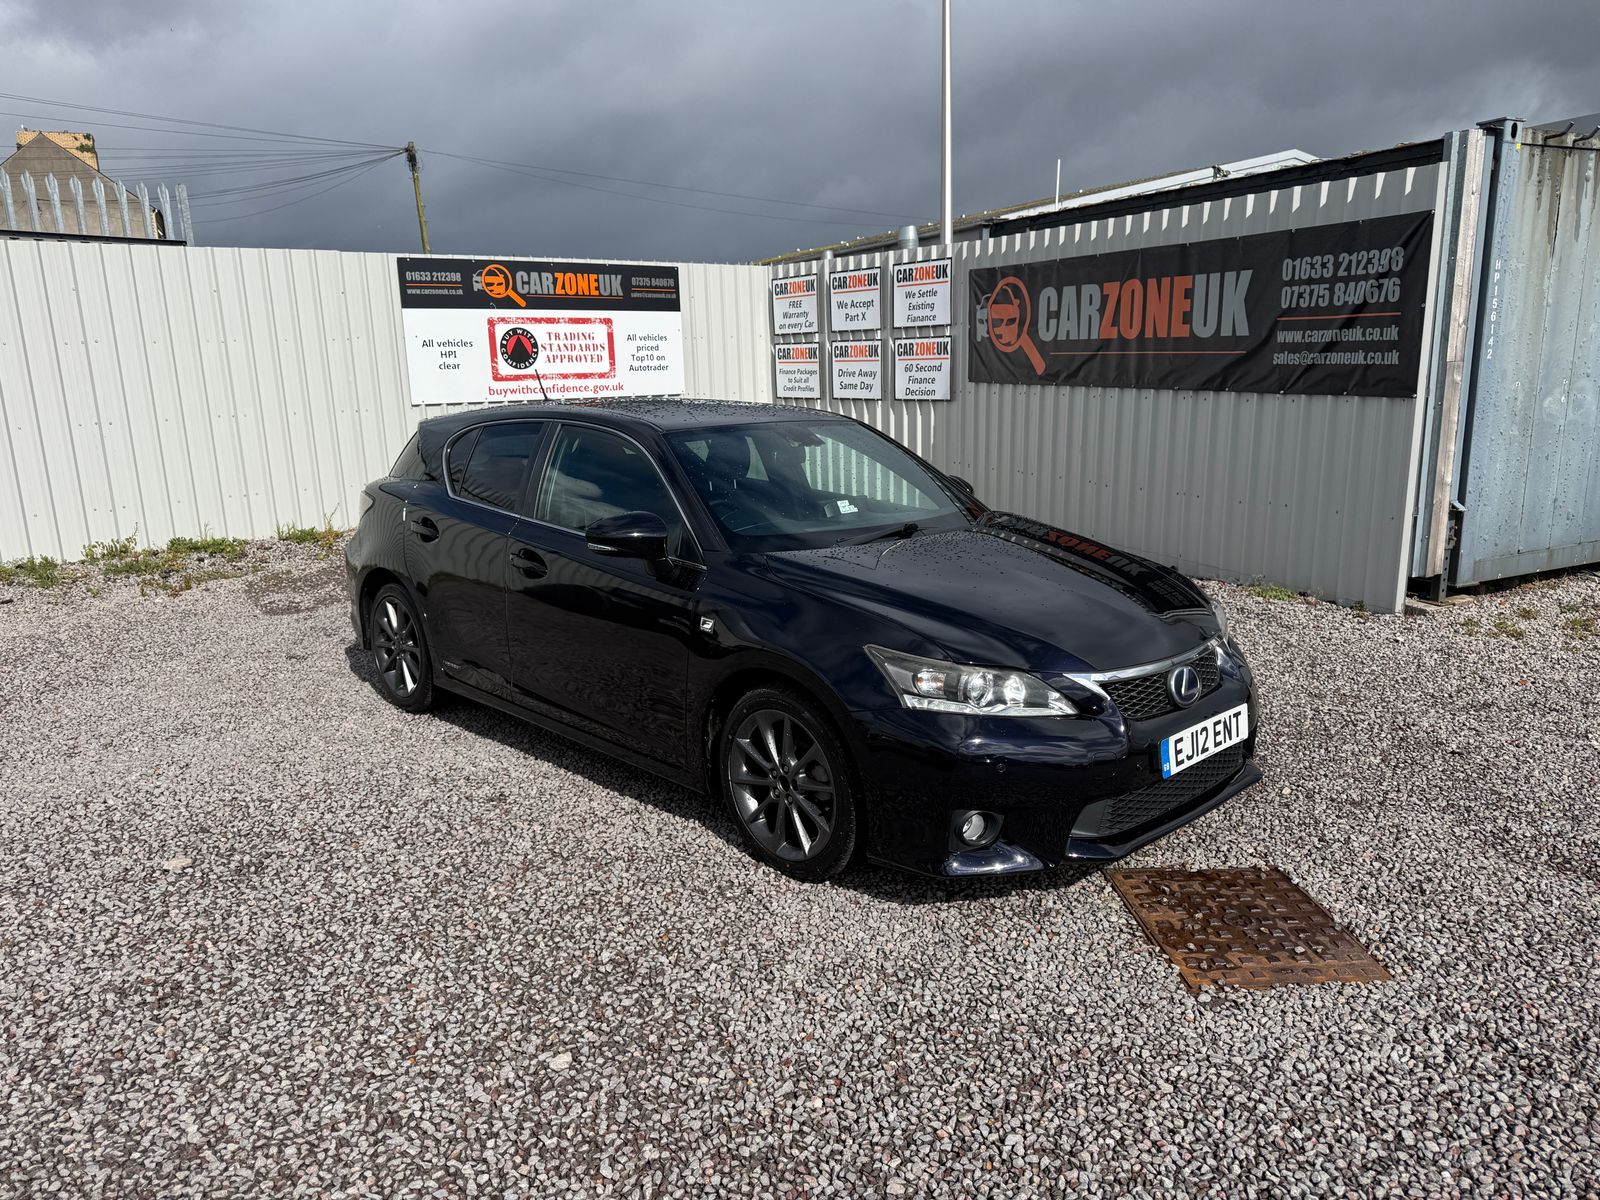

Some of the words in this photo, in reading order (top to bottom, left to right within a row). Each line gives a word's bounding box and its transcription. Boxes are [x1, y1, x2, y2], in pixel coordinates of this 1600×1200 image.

[1282, 254, 1335, 281] 01633
[1338, 247, 1405, 276] 212398
[406, 271, 431, 281] 01633
[432, 272, 461, 281] 212398
[897, 264, 948, 283] CARZONEUK
[515, 271, 623, 297] CARZONEUK
[832, 273, 878, 290] CARZONEUK
[774, 279, 815, 296] CARZONEUK
[905, 291, 915, 299] We
[917, 290, 938, 298] Settle
[1280, 282, 1330, 309] 07375
[1334, 278, 1401, 306] 840676
[789, 301, 802, 309] FREE
[837, 301, 848, 310] We
[850, 300, 874, 309] Accept
[908, 302, 935, 311] Existing
[1037, 269, 1253, 342] CARZONEUK
[782, 311, 809, 320] Warranty
[845, 313, 860, 322] Part
[861, 312, 866, 321] X
[907, 314, 937, 323] Fianance
[787, 322, 803, 330] every
[502, 331, 513, 344] BUY
[517, 329, 535, 343] WITH
[546, 332, 595, 341] TRADING
[626, 334, 637, 342] All
[639, 334, 668, 342] vehicles
[1276, 326, 1399, 343] www.carzoneuk.co.uk
[422, 339, 434, 348] All
[436, 339, 473, 348] vehicles
[541, 343, 606, 353] STANDARDS
[636, 343, 660, 352] priced
[777, 347, 818, 360] CARZONEUK
[834, 344, 879, 358] CARZONEUK
[897, 342, 949, 357] CARZONEUK
[440, 350, 457, 360] HPI
[501, 348, 537, 368] CONFIDENCE
[545, 353, 604, 364] APPROVED
[631, 354, 654, 363] Top10
[1272, 350, 1399, 367] sales@carzoneuk.co.uk
[438, 361, 460, 370] clear
[629, 363, 669, 372] Autotrader
[904, 364, 914, 372] 60
[915, 363, 942, 372] Second
[837, 369, 856, 377] Drive
[857, 369, 877, 380] Away
[908, 376, 936, 384] Finance
[839, 382, 858, 390] Same
[860, 382, 874, 392] Day
[905, 387, 936, 396] Decision
[1175, 726, 1209, 767] EJ12
[1213, 711, 1241, 748] ENT
